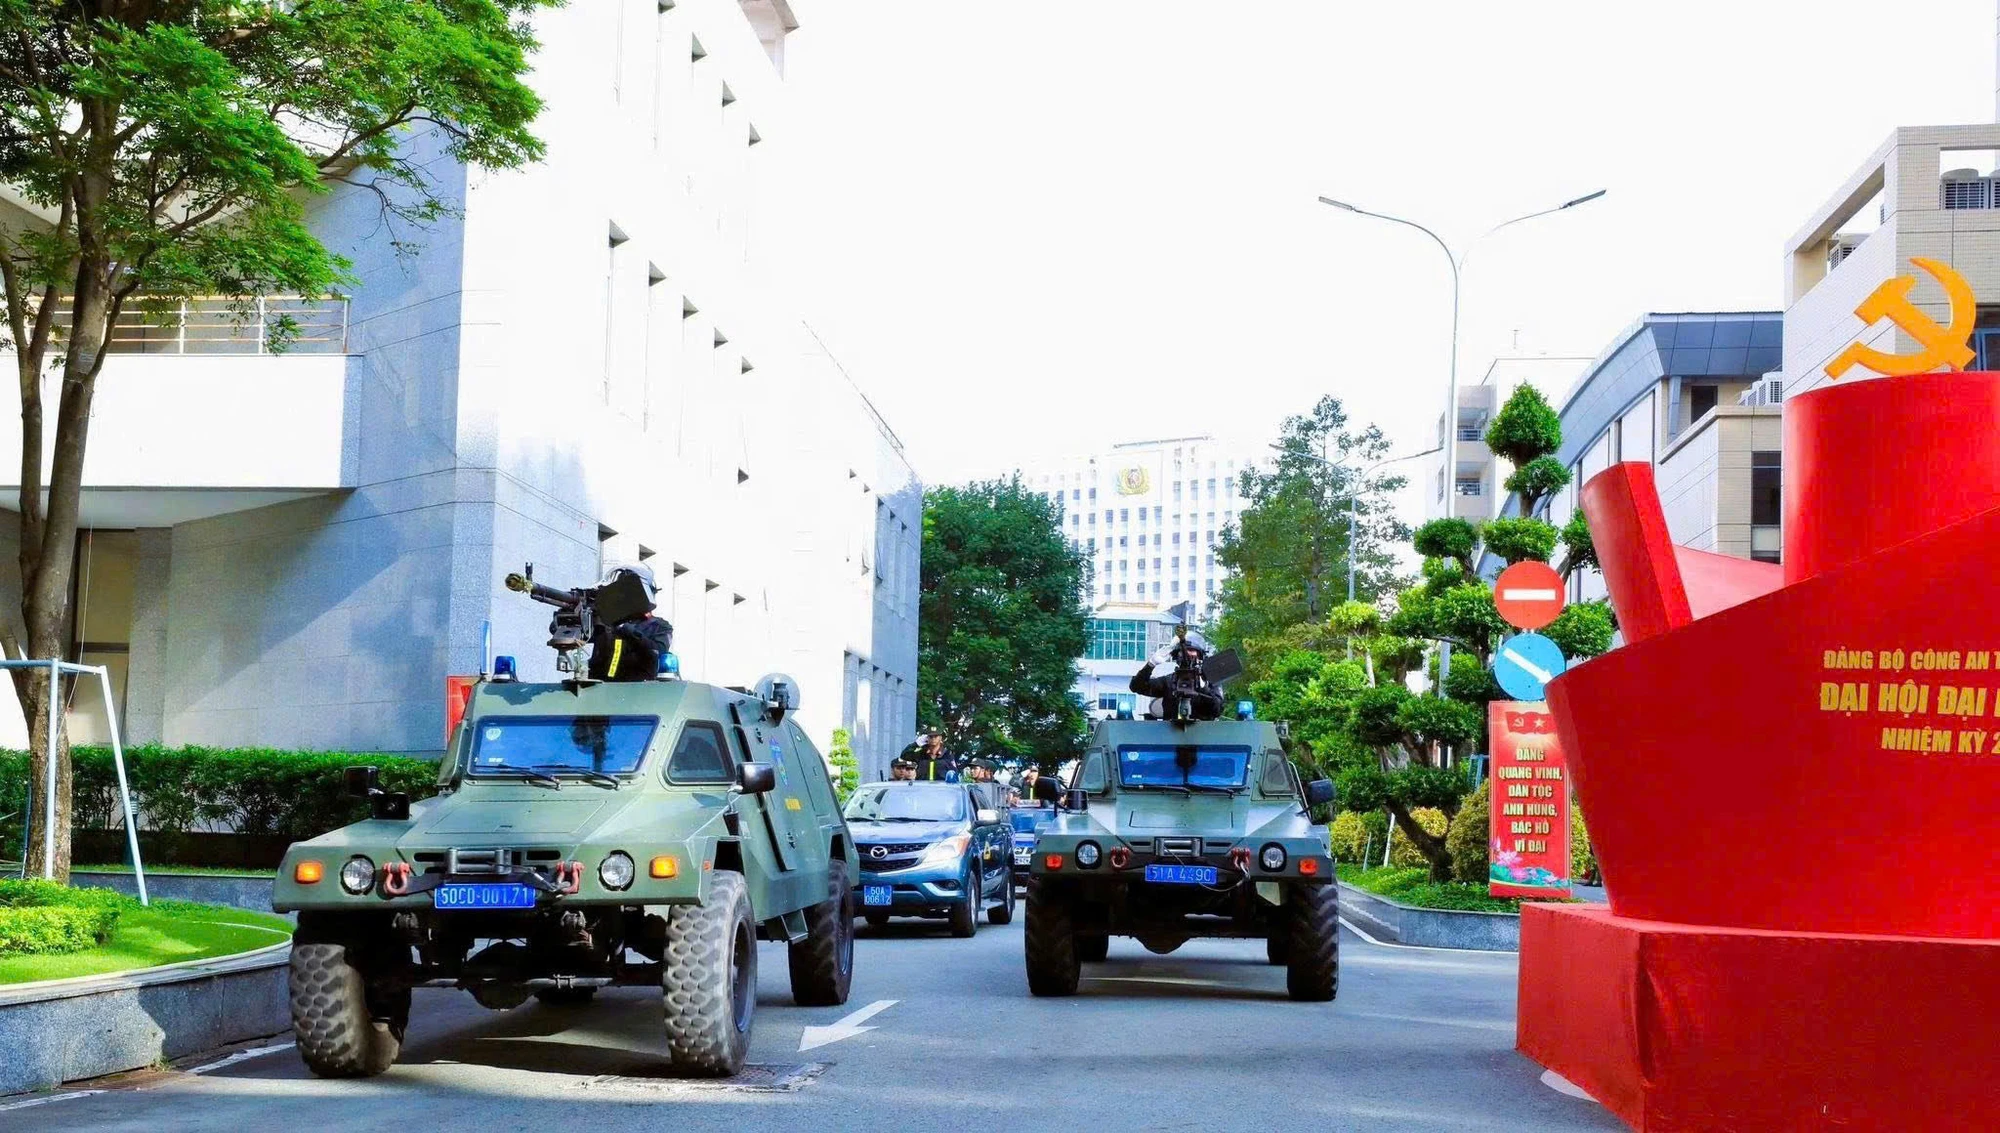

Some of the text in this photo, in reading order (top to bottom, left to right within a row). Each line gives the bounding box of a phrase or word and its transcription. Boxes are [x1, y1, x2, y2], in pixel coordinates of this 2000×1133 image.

[1823, 646, 1873, 669] ĐẢNG
[1879, 648, 1905, 672] BỘ
[1911, 648, 1960, 670] CÔNG
[1965, 651, 1990, 670] AN
[1820, 682, 1869, 717] ĐẠI
[1878, 679, 1929, 718] HỘI
[1937, 685, 1987, 721] ĐẠI
[1881, 726, 1952, 755] NHIỆM
[1958, 728, 1987, 753] KỲ
[1498, 766, 1562, 780] QUANG VINH,
[1503, 803, 1524, 815] ANH
[1511, 819, 1532, 834] BÁC
